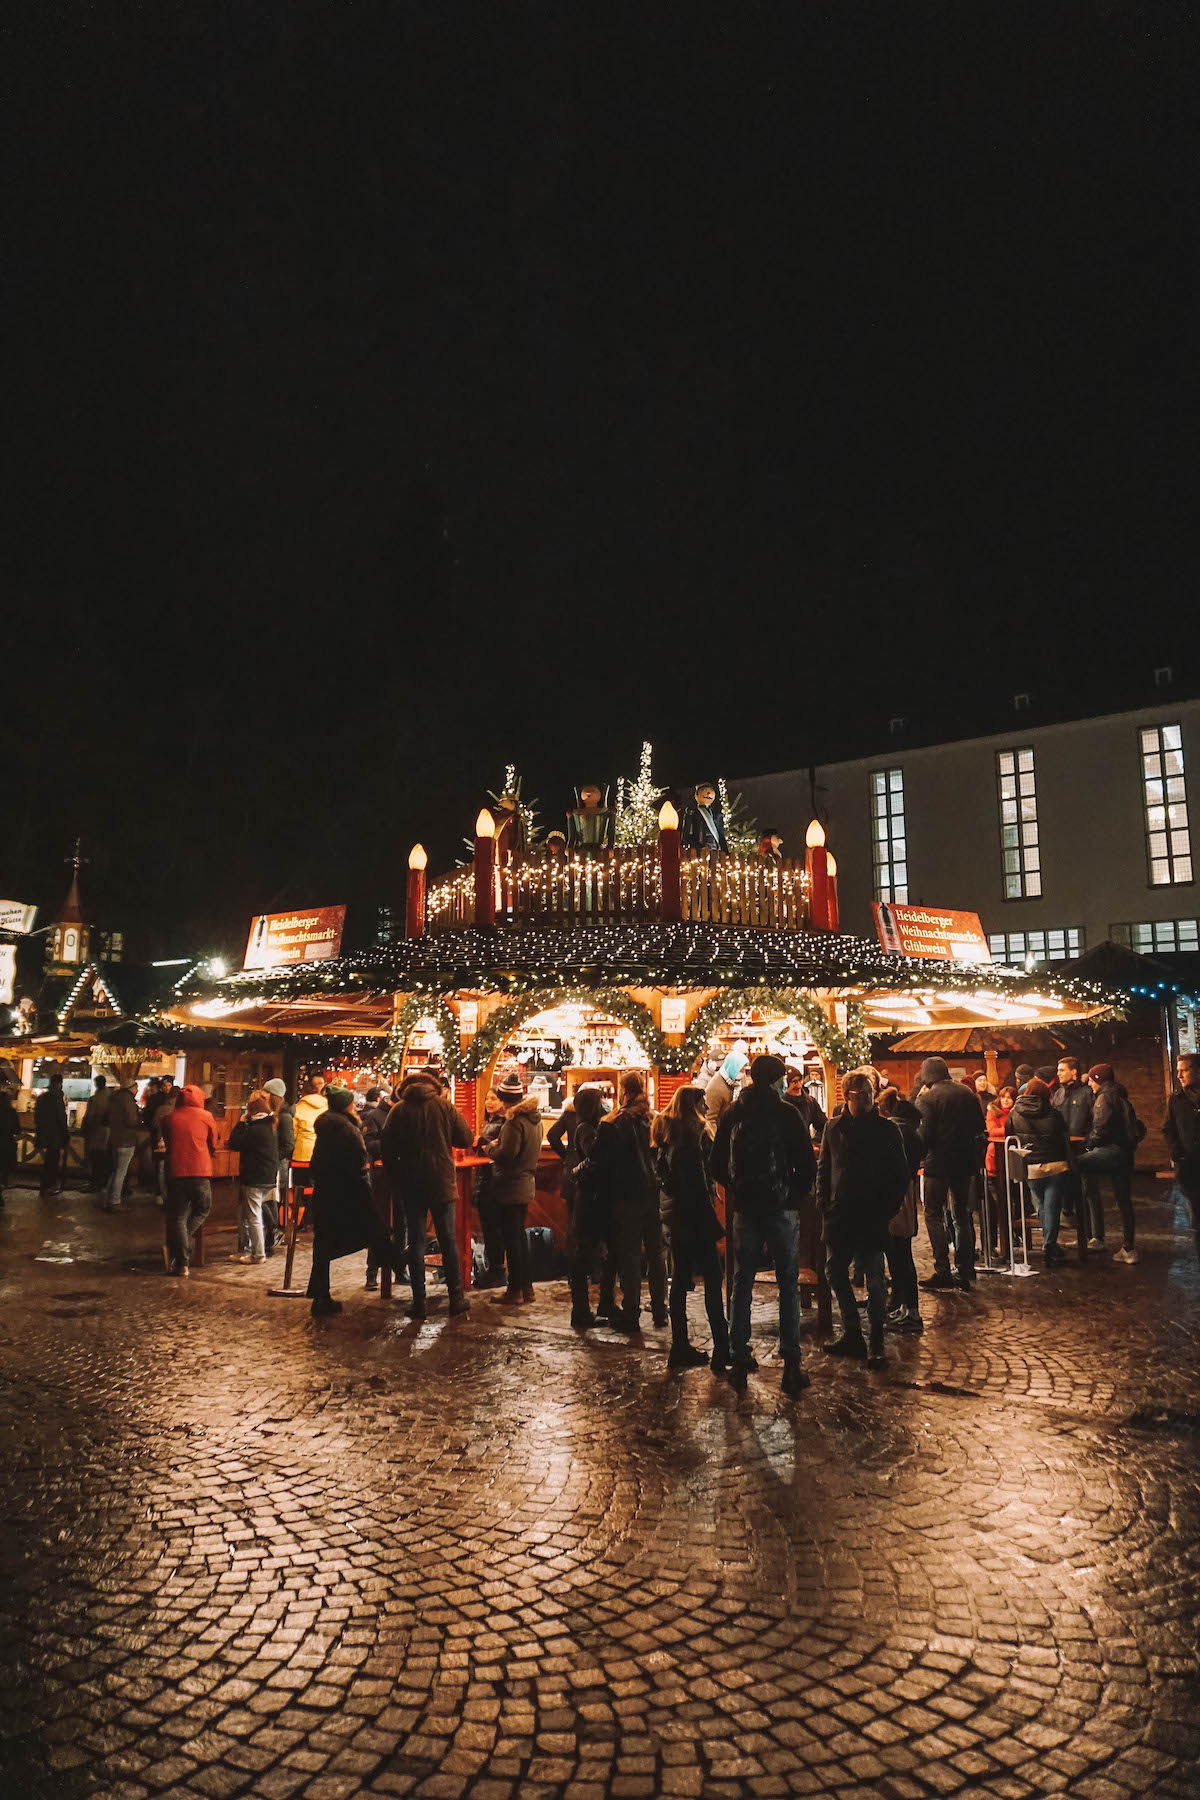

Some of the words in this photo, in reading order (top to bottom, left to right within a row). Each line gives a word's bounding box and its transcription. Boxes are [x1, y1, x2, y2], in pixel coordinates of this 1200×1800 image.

[269, 917, 319, 931] Heidelberger
[895, 909, 953, 928] Heidelberger
[899, 924, 981, 943] Weihnachtsmarkt-
[903, 939, 947, 955] Glühwein
